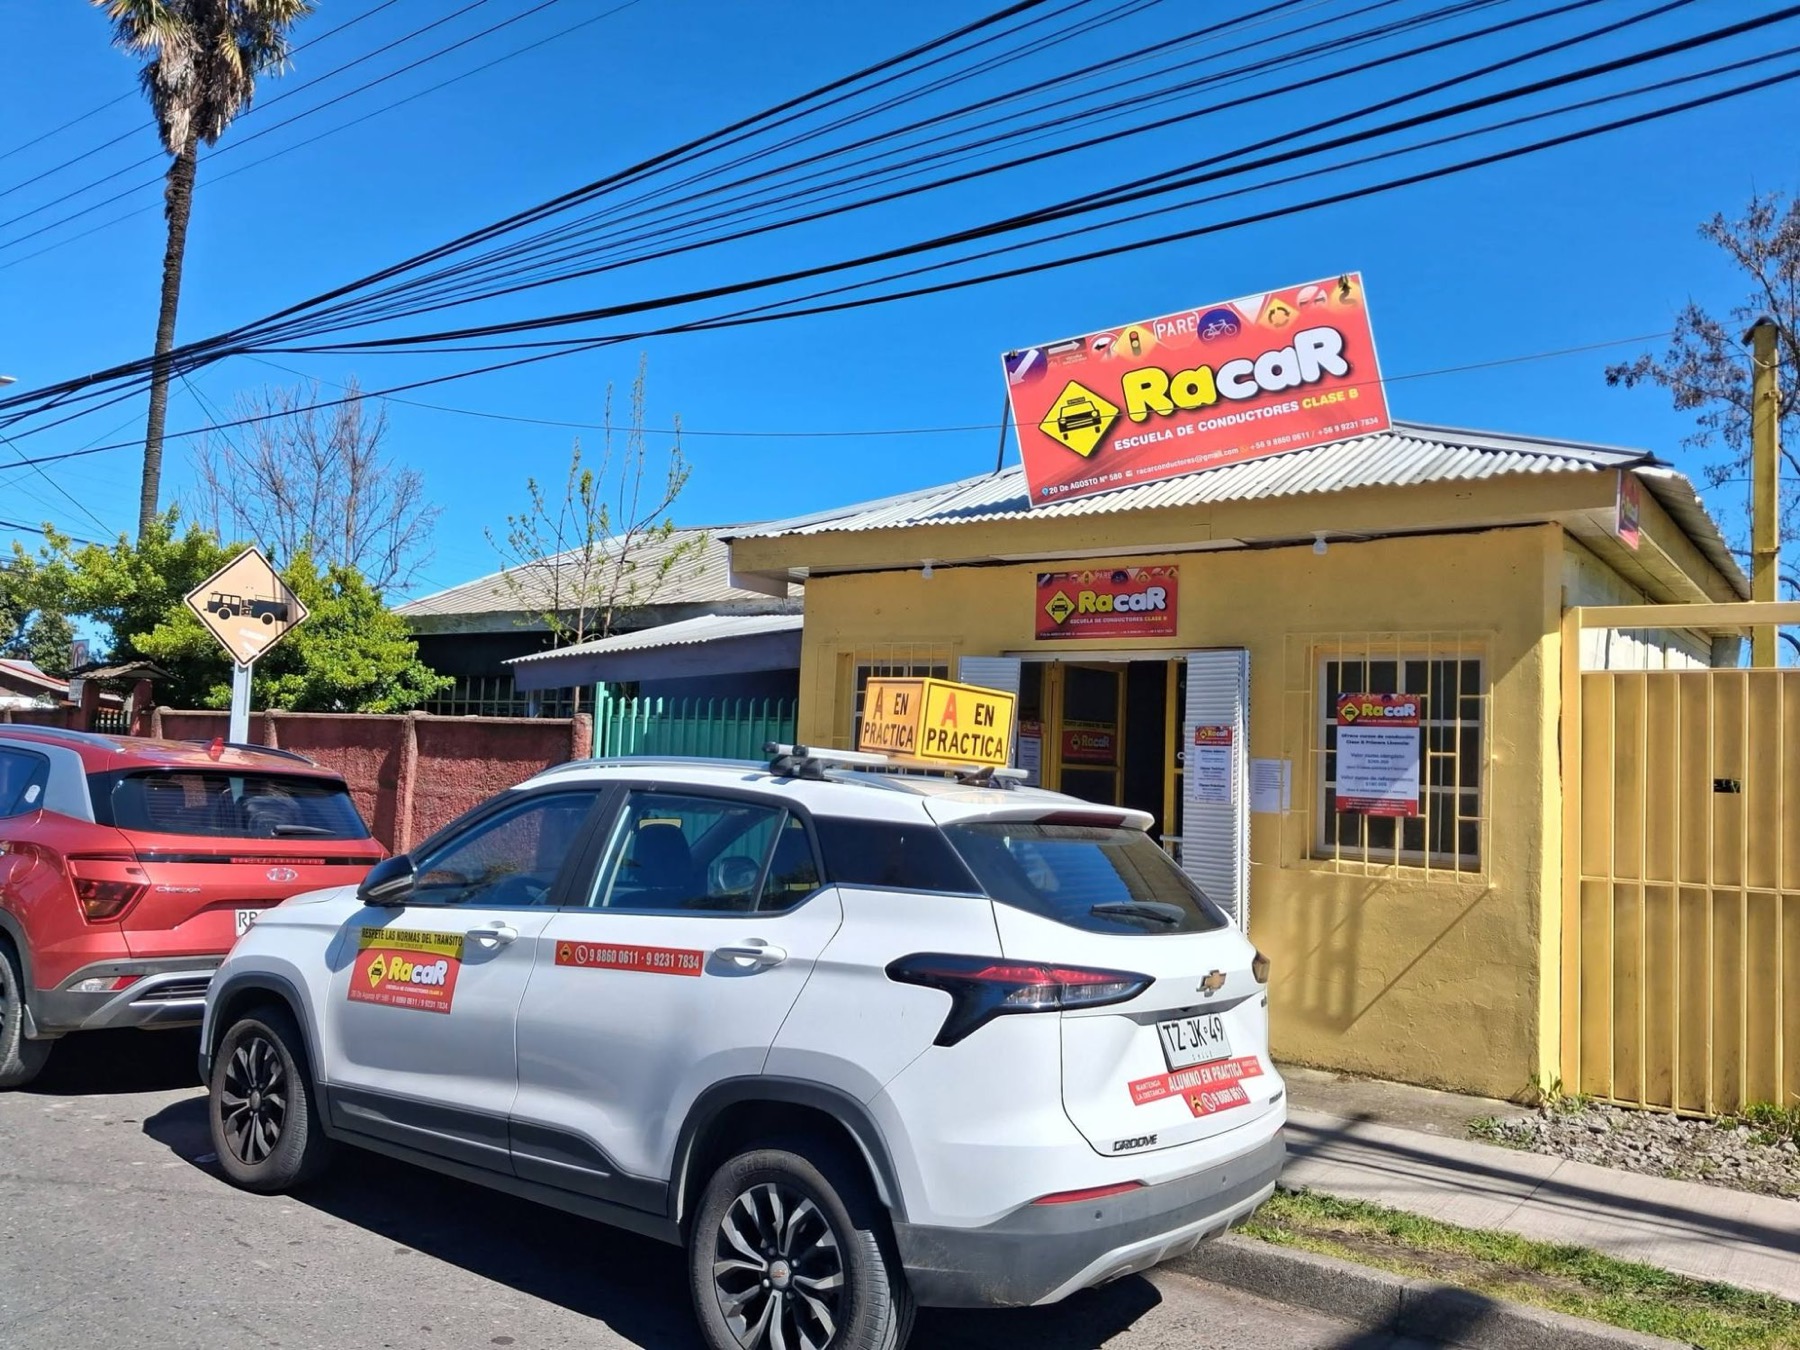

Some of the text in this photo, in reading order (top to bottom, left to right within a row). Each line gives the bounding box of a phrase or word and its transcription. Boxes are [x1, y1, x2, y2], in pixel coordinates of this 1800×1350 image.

[1156, 316, 1198, 340] PARE
[1114, 388, 1359, 450] ESCUELA DE CONDUCTORES CLASE B
[1070, 478, 1098, 490] AGOSTO
[1109, 472, 1123, 481] 580
[1136, 448, 1239, 475] racarconductores@gmail.com
[1318, 426, 1333, 435] +56
[1334, 424, 1340, 432] 9
[1341, 420, 1359, 431] 9231
[1360, 417, 1379, 427] 7834
[873, 686, 909, 720] A EN
[940, 692, 995, 729] A EN
[863, 722, 913, 749] PRACTICA
[926, 728, 1004, 759] PRACTICA
[361, 927, 384, 940] RESPETE
[385, 930, 395, 941] LAS
[397, 931, 420, 943] NORMAS
[421, 933, 432, 944] DEL
[434, 934, 463, 947] TRANSITO
[589, 949, 594, 961] 9
[596, 949, 616, 963] 8860
[618, 950, 638, 964] 0611
[646, 951, 652, 965] 9
[653, 953, 674, 967] 9231
[678, 954, 699, 969] 7834
[1167, 1062, 1244, 1092] ALUMNO EN PRACTICA
[1113, 1134, 1158, 1151] GROOVE
